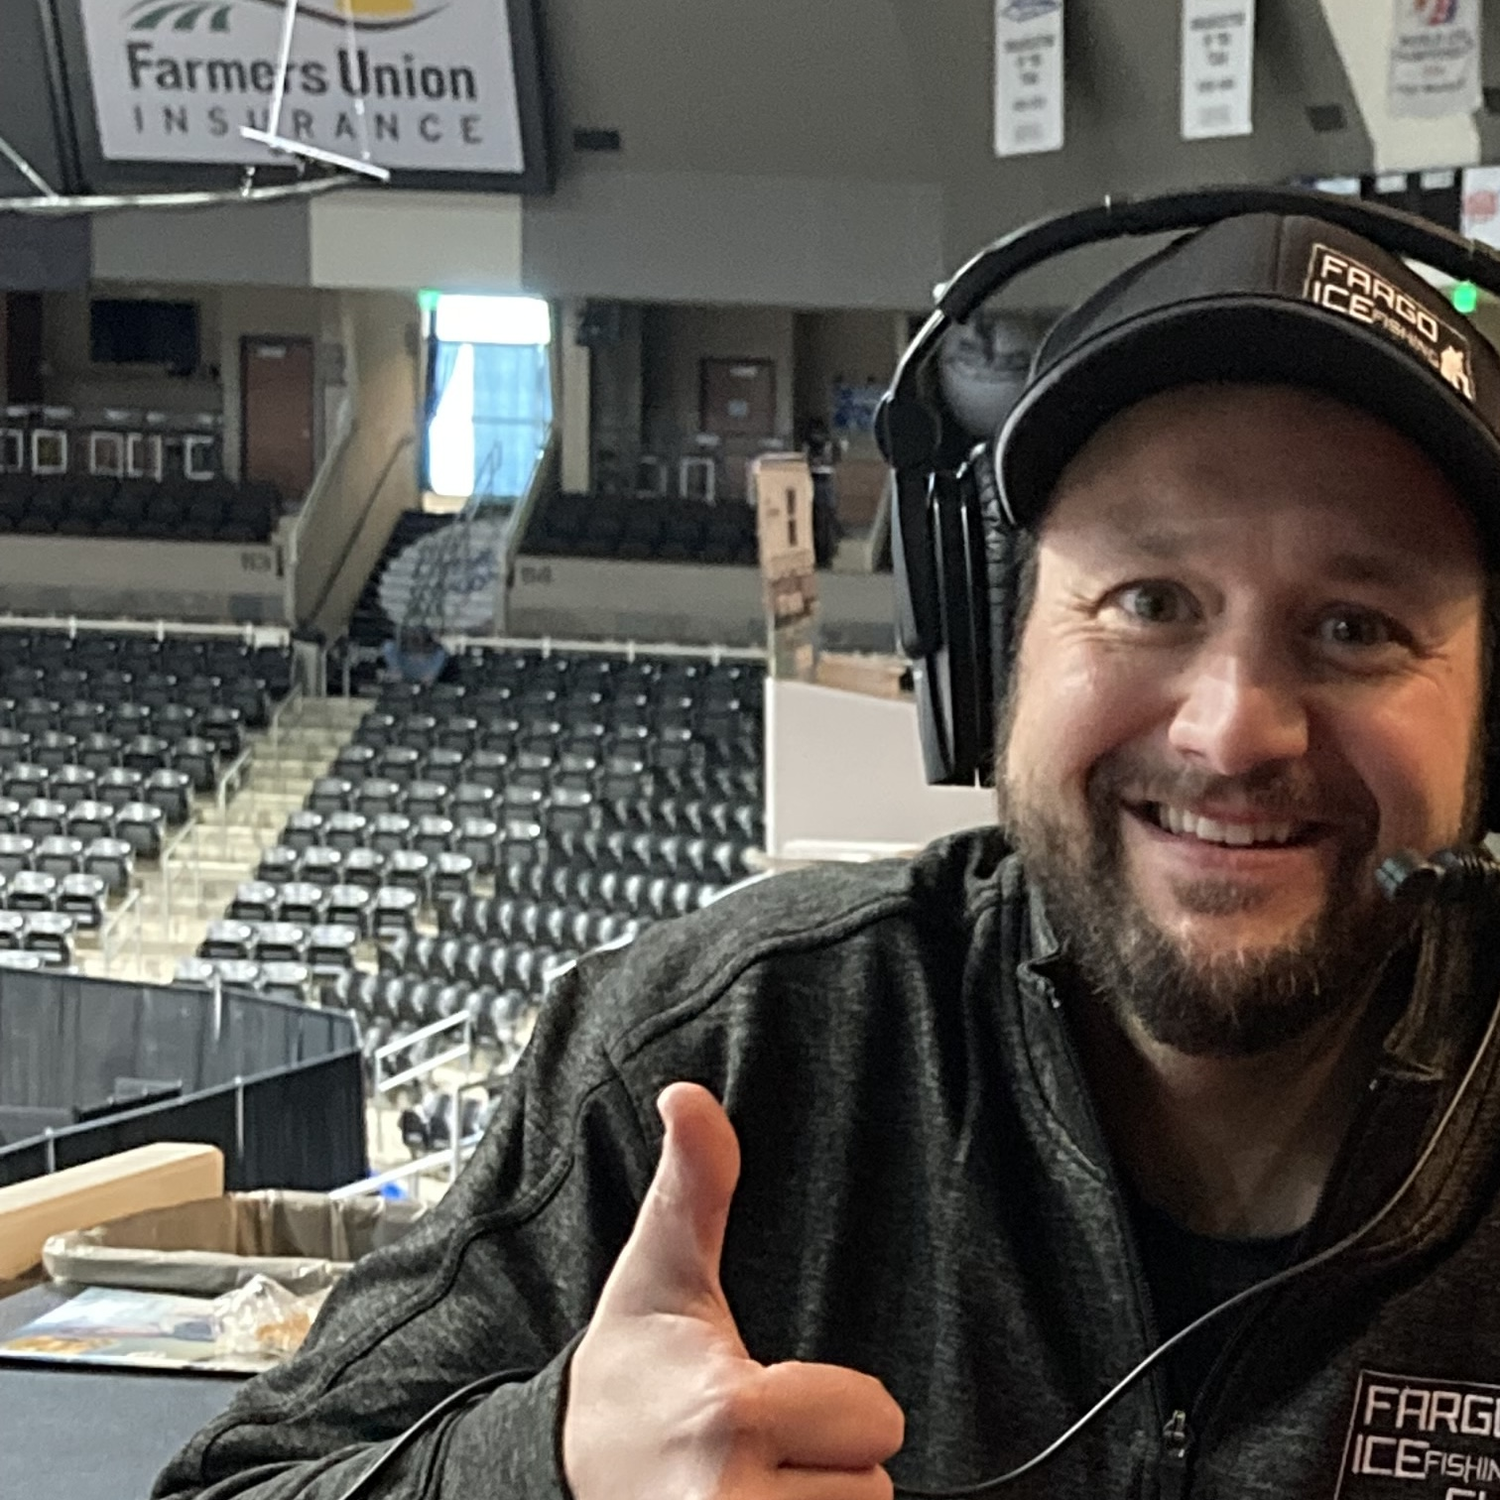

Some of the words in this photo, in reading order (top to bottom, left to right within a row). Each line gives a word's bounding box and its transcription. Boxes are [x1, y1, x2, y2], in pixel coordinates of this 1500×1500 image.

[126, 40, 328, 96] Farmers
[337, 48, 478, 101] Union
[133, 105, 484, 145] INSURANCE
[1313, 281, 1375, 325] ICE
[1320, 254, 1439, 343] FARGO
[1351, 1433, 1430, 1480] ICE
